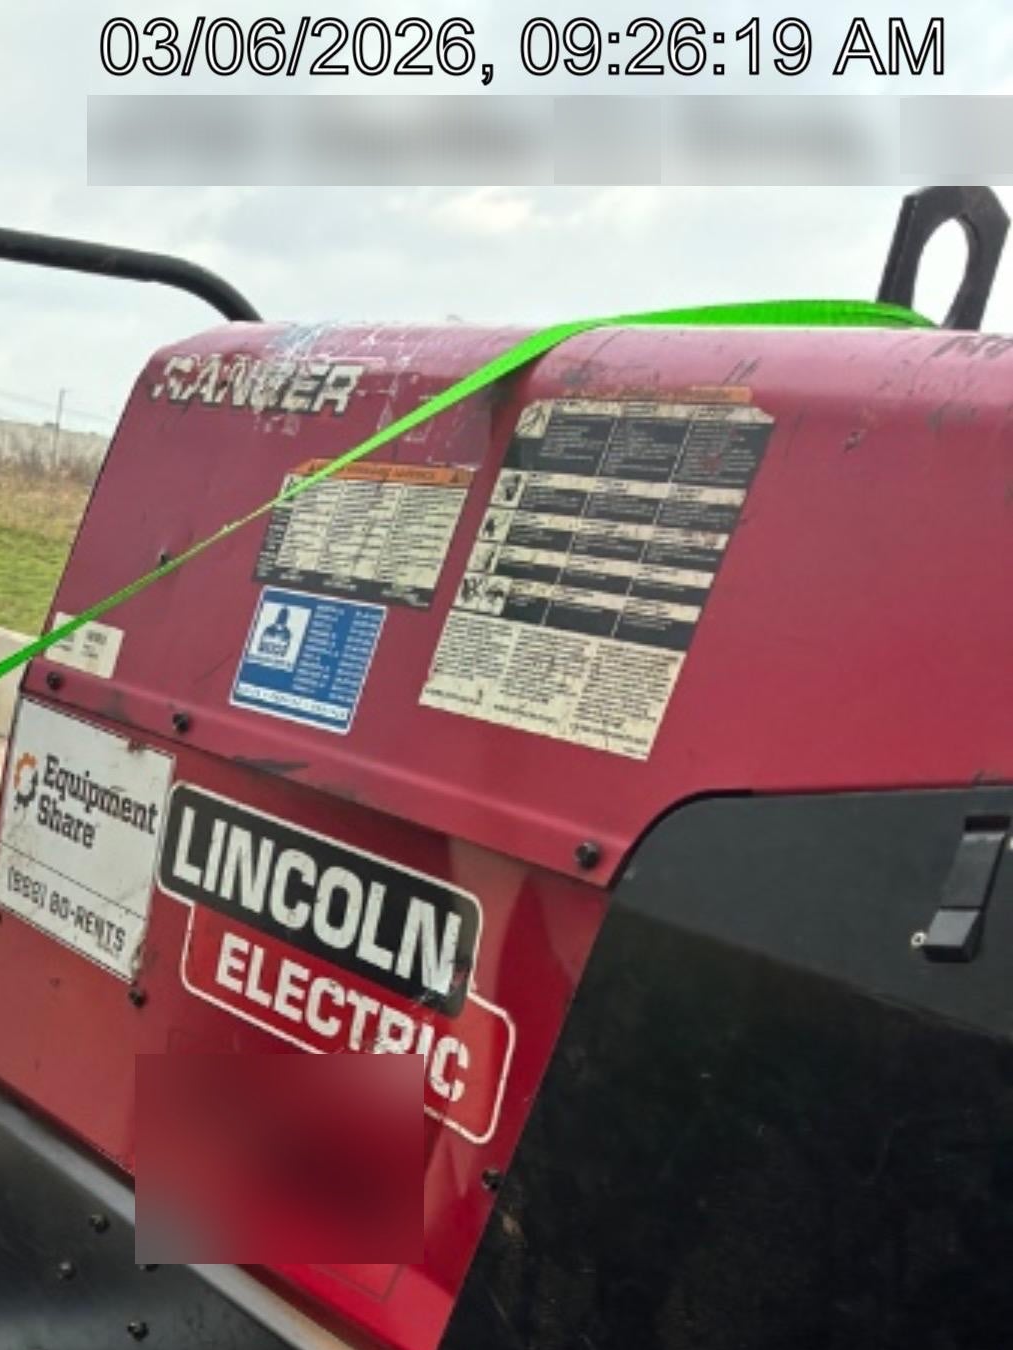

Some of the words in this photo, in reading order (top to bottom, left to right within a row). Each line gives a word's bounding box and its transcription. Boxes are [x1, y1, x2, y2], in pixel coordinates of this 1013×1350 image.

[38, 794, 96, 849] Share
[43, 755, 158, 834] Equipment
[49, 889, 126, 953] 80-RENTS
[172, 806, 462, 996] LINCOLN
